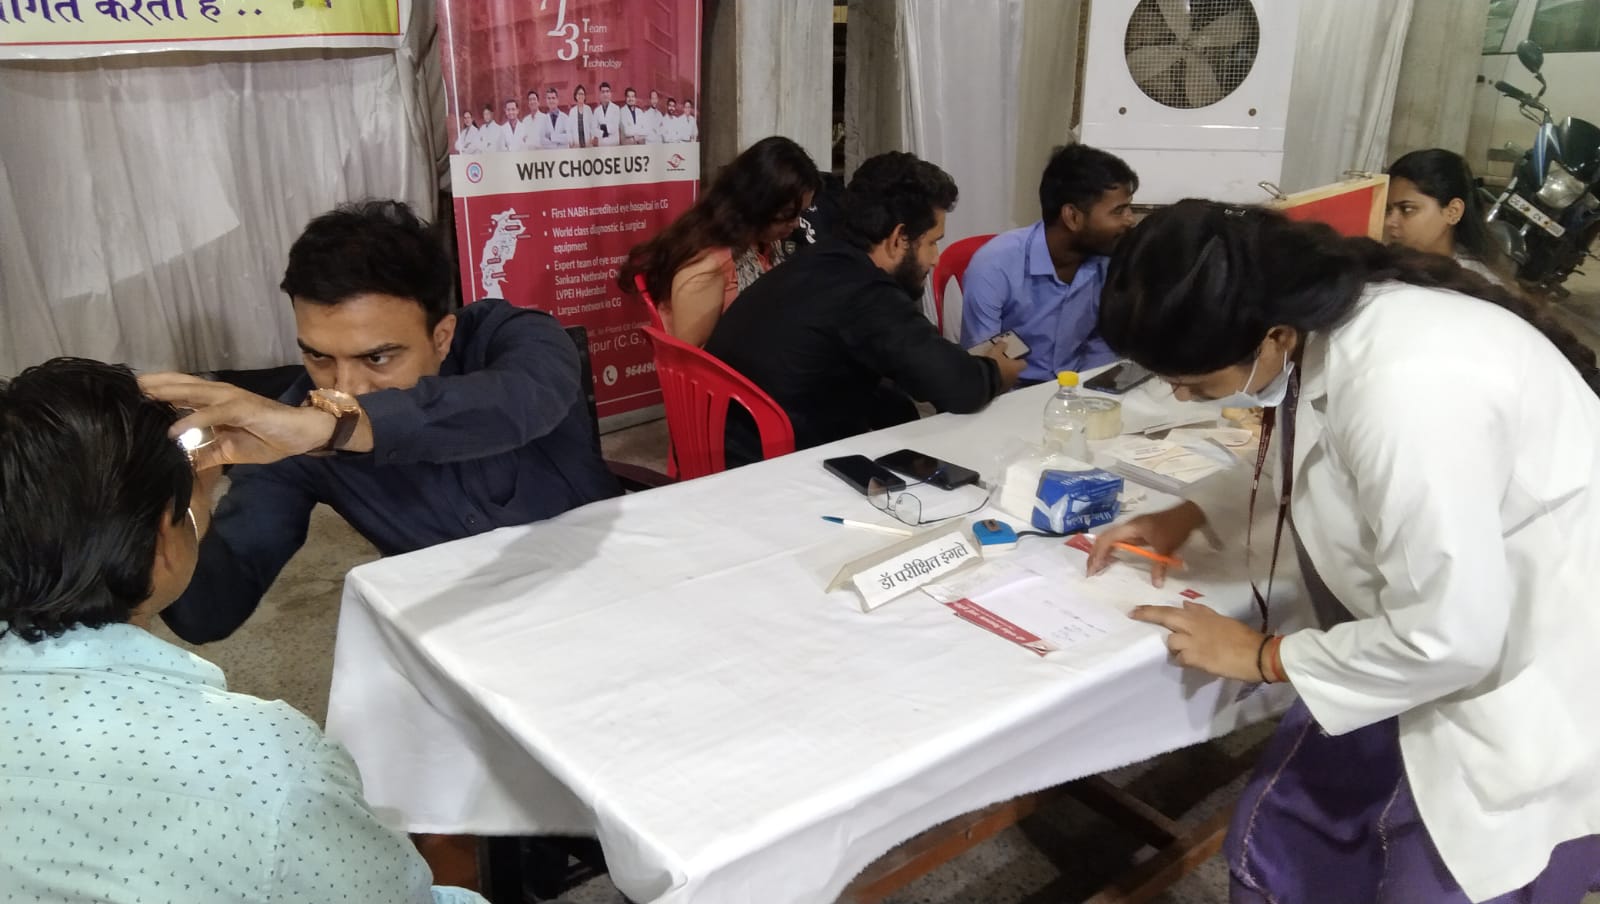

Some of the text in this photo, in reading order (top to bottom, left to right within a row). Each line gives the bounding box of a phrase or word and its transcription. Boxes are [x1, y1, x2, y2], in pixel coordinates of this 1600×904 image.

[582, 18, 607, 33] Team
[582, 38, 604, 53] Trust
[582, 55, 622, 69] Technology
[516, 156, 650, 180] WHY CHOOSE US?
[551, 199, 669, 219] First NABH accredited eye hospital in CG
[552, 219, 647, 239] World class diagnostic & surgical
[553, 242, 588, 254] equipment
[554, 260, 575, 272] Expert
[576, 259, 592, 269] team
[592, 256, 599, 266] of
[599, 257, 608, 267] eye
[555, 274, 580, 286] Sankara
[556, 284, 607, 300] LVPEI Hyderabad
[557, 297, 621, 317] Largest network in CG
[894, 558, 941, 583] परीक्षित
[939, 541, 968, 565] इंगले
